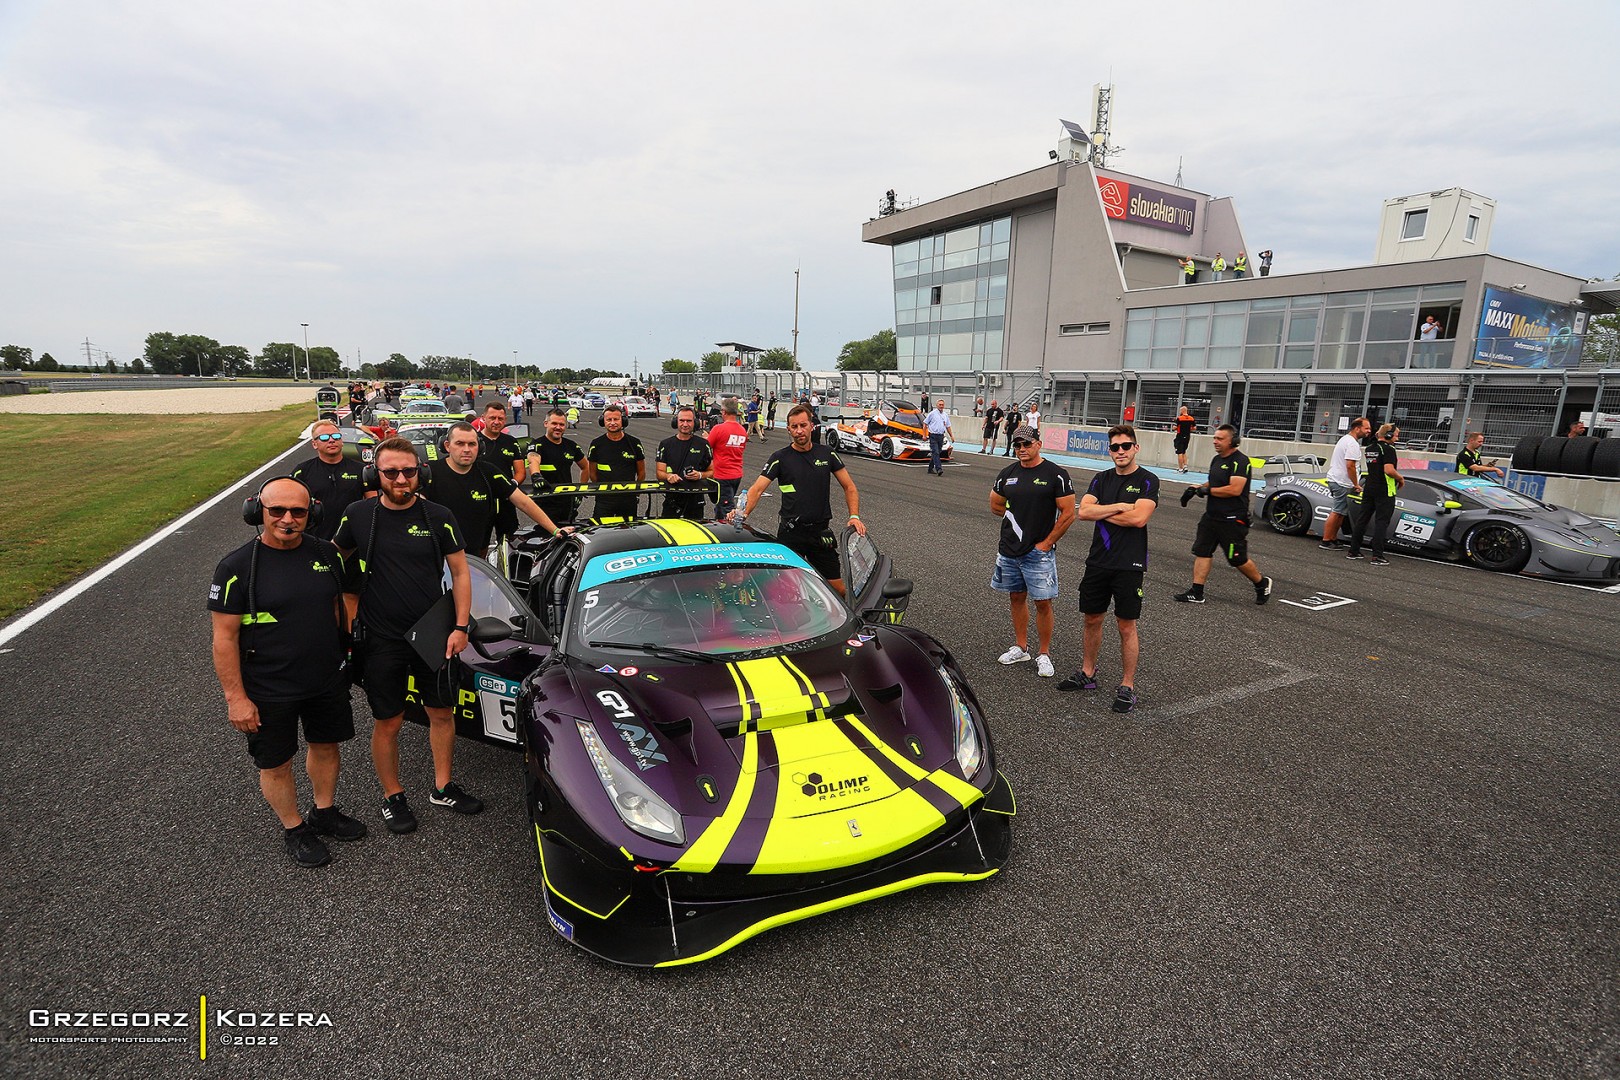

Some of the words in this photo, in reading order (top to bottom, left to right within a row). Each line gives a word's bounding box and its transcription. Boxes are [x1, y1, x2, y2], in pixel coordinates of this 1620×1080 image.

[1130, 193, 1193, 231] slovakiaring
[726, 434, 746, 446] RP
[554, 482, 661, 494] OLIMP
[1403, 523, 1423, 534] 78
[668, 547, 703, 555] Digital
[705, 545, 744, 553] Security
[672, 552, 729, 563] Progress.
[730, 551, 788, 562] Protected.
[583, 590, 600, 609] 5
[596, 690, 635, 719] GP1
[499, 699, 517, 732] 5
[622, 730, 648, 767] www.gp1.tv
[817, 776, 868, 794] OLIMP
[819, 786, 871, 801] RACING
